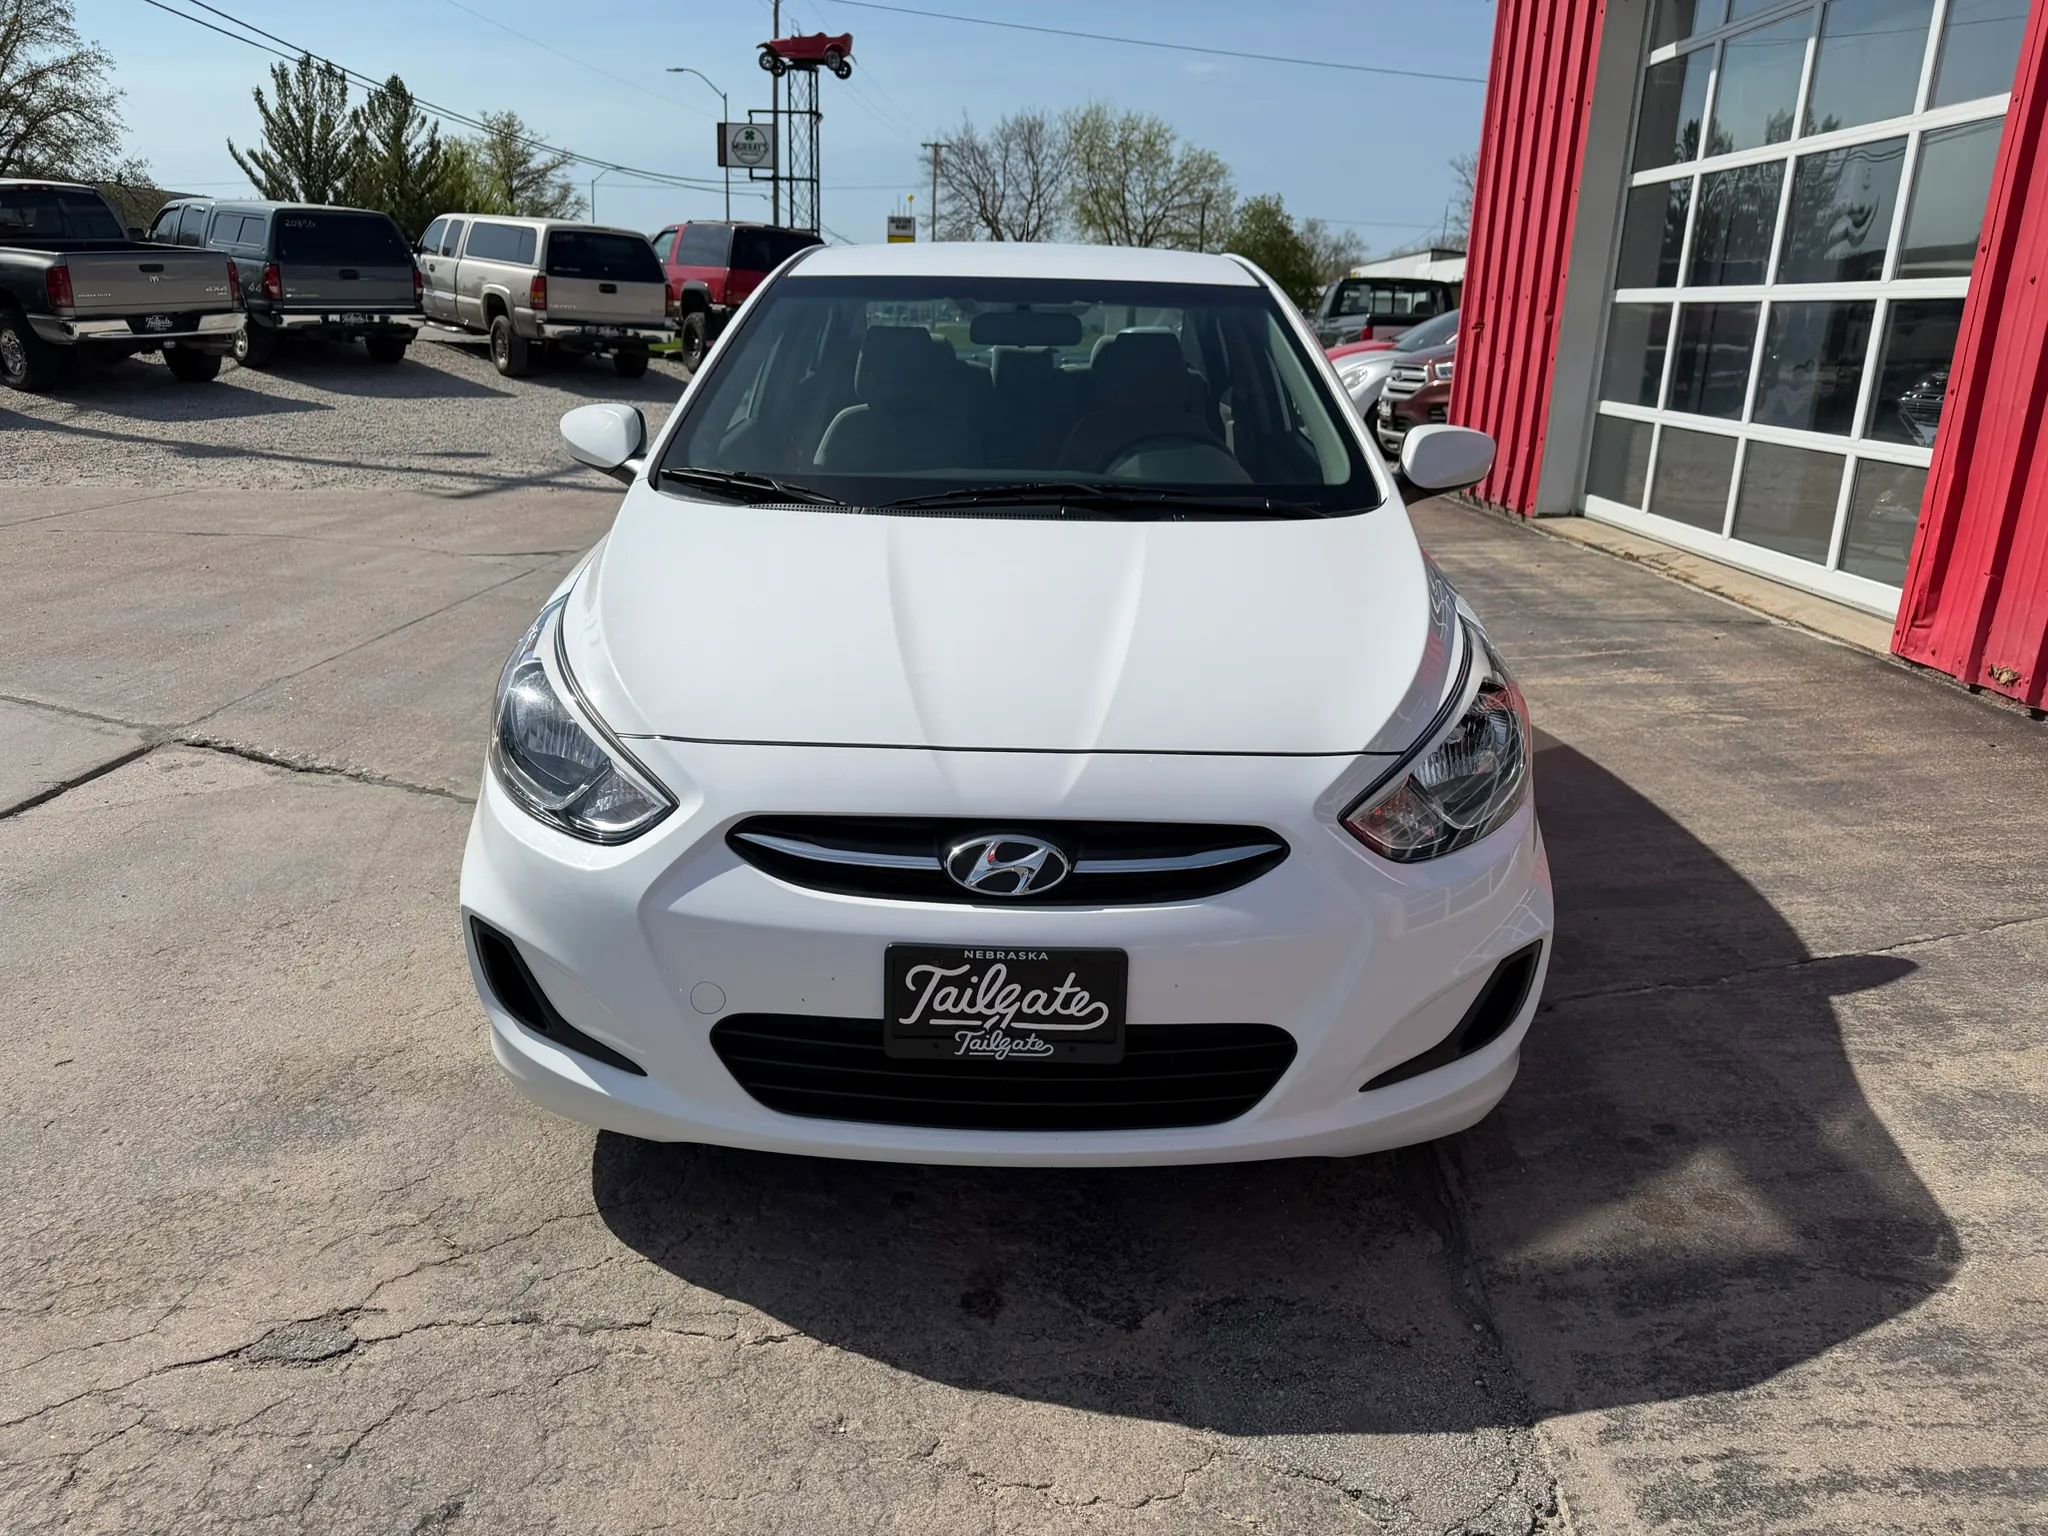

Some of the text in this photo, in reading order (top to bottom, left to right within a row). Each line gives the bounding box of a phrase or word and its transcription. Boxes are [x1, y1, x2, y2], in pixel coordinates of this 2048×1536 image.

[964, 950, 1049, 961] NEBRASKA
[898, 962, 1109, 1031] Tailgate
[954, 1029, 1055, 1061] Tailgate
